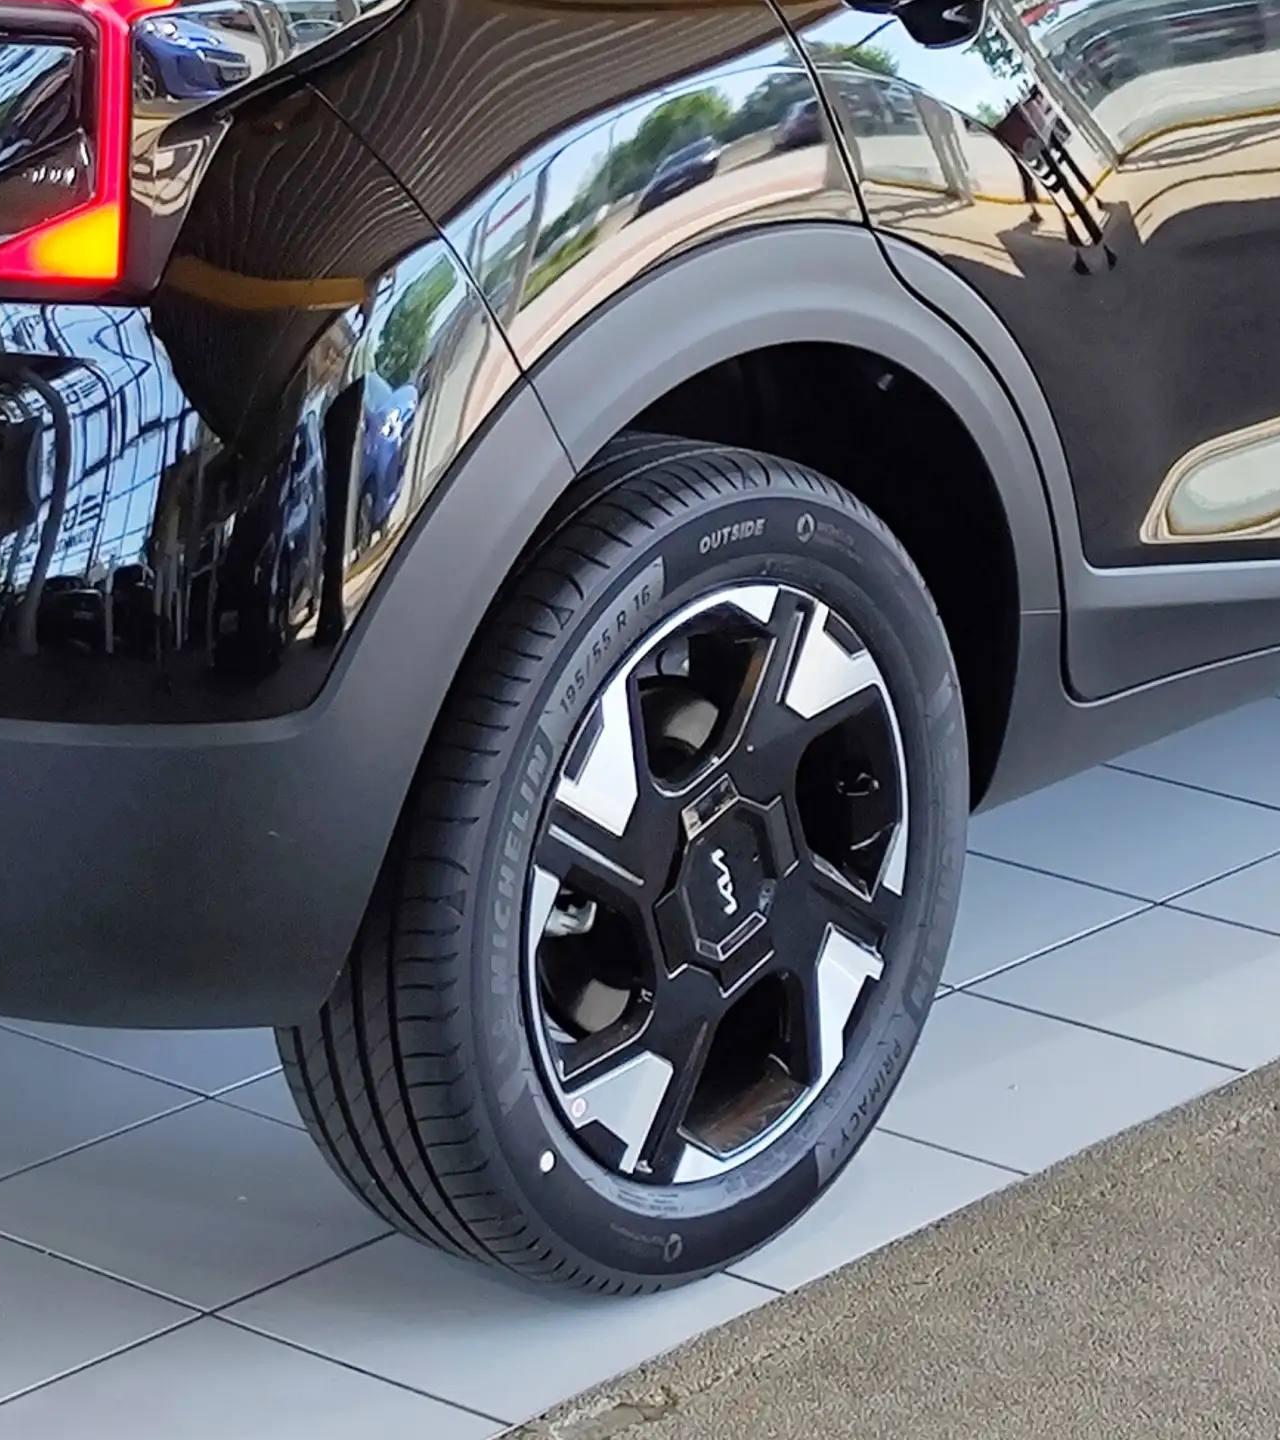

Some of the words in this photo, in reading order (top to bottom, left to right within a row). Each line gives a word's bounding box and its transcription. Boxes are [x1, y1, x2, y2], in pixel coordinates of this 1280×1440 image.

[699, 517, 767, 555] OUTSIDE
[559, 627, 612, 714] 195/55
[632, 584, 653, 611] 16
[491, 730, 554, 1006] MICHELIN
[709, 844, 739, 918] KIA
[839, 1037, 903, 1149] PRIMACY
